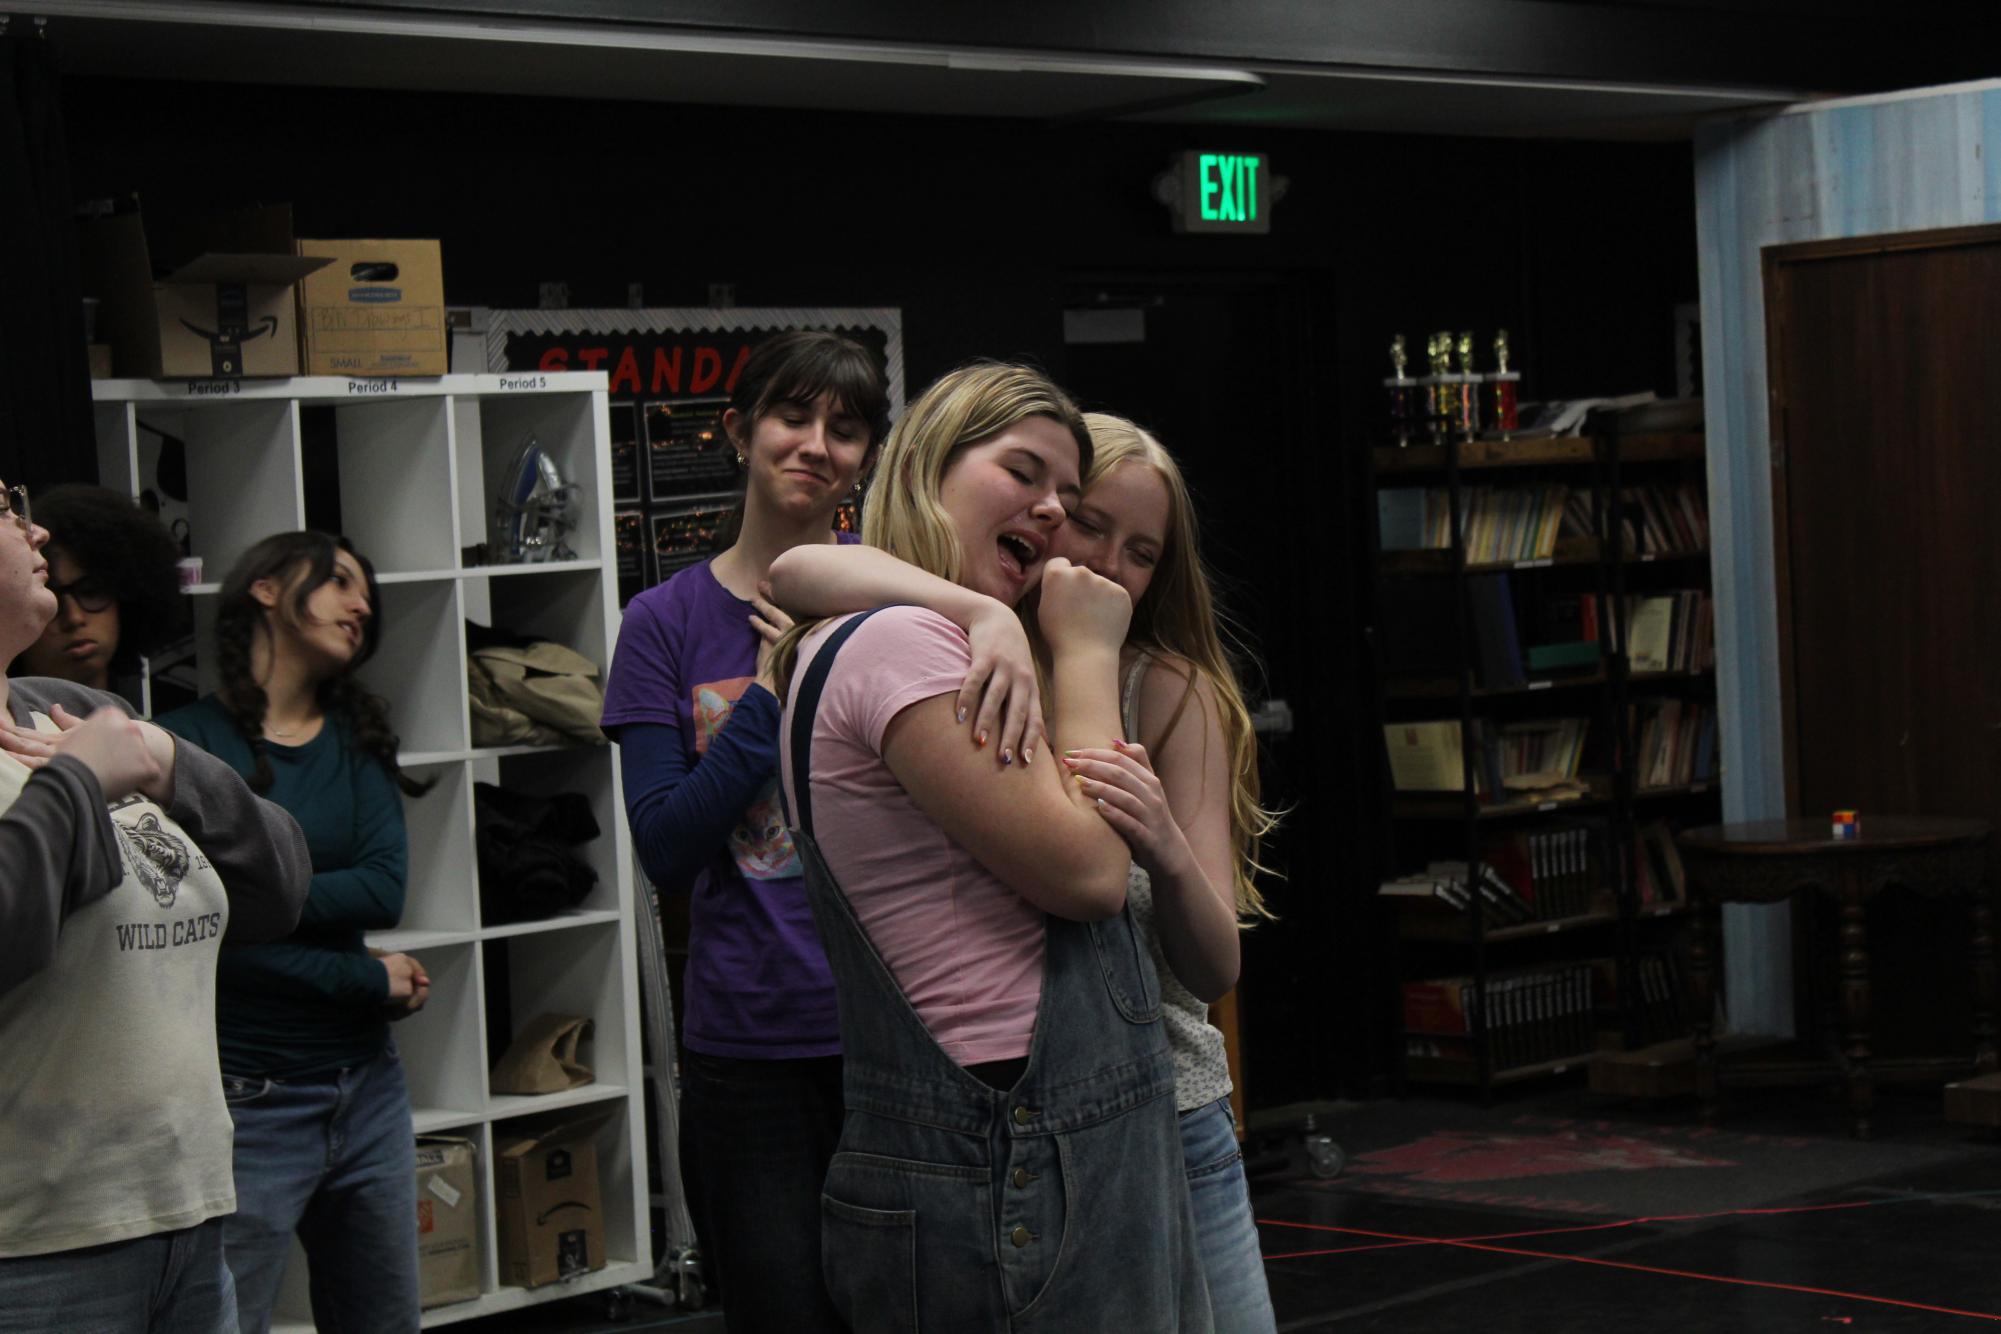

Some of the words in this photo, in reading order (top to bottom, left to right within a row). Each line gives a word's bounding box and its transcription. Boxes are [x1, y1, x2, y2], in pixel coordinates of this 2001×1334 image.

[1200, 154, 1260, 221] EXIT
[188, 382, 230, 394] Period
[233, 381, 241, 393] 3
[349, 380, 387, 393] Period
[390, 380, 398, 392] 4
[500, 375, 537, 389] Period
[539, 376, 546, 388] 5
[194, 854, 212, 870] 19
[116, 923, 167, 951] WILD
[172, 912, 221, 946] CATS
